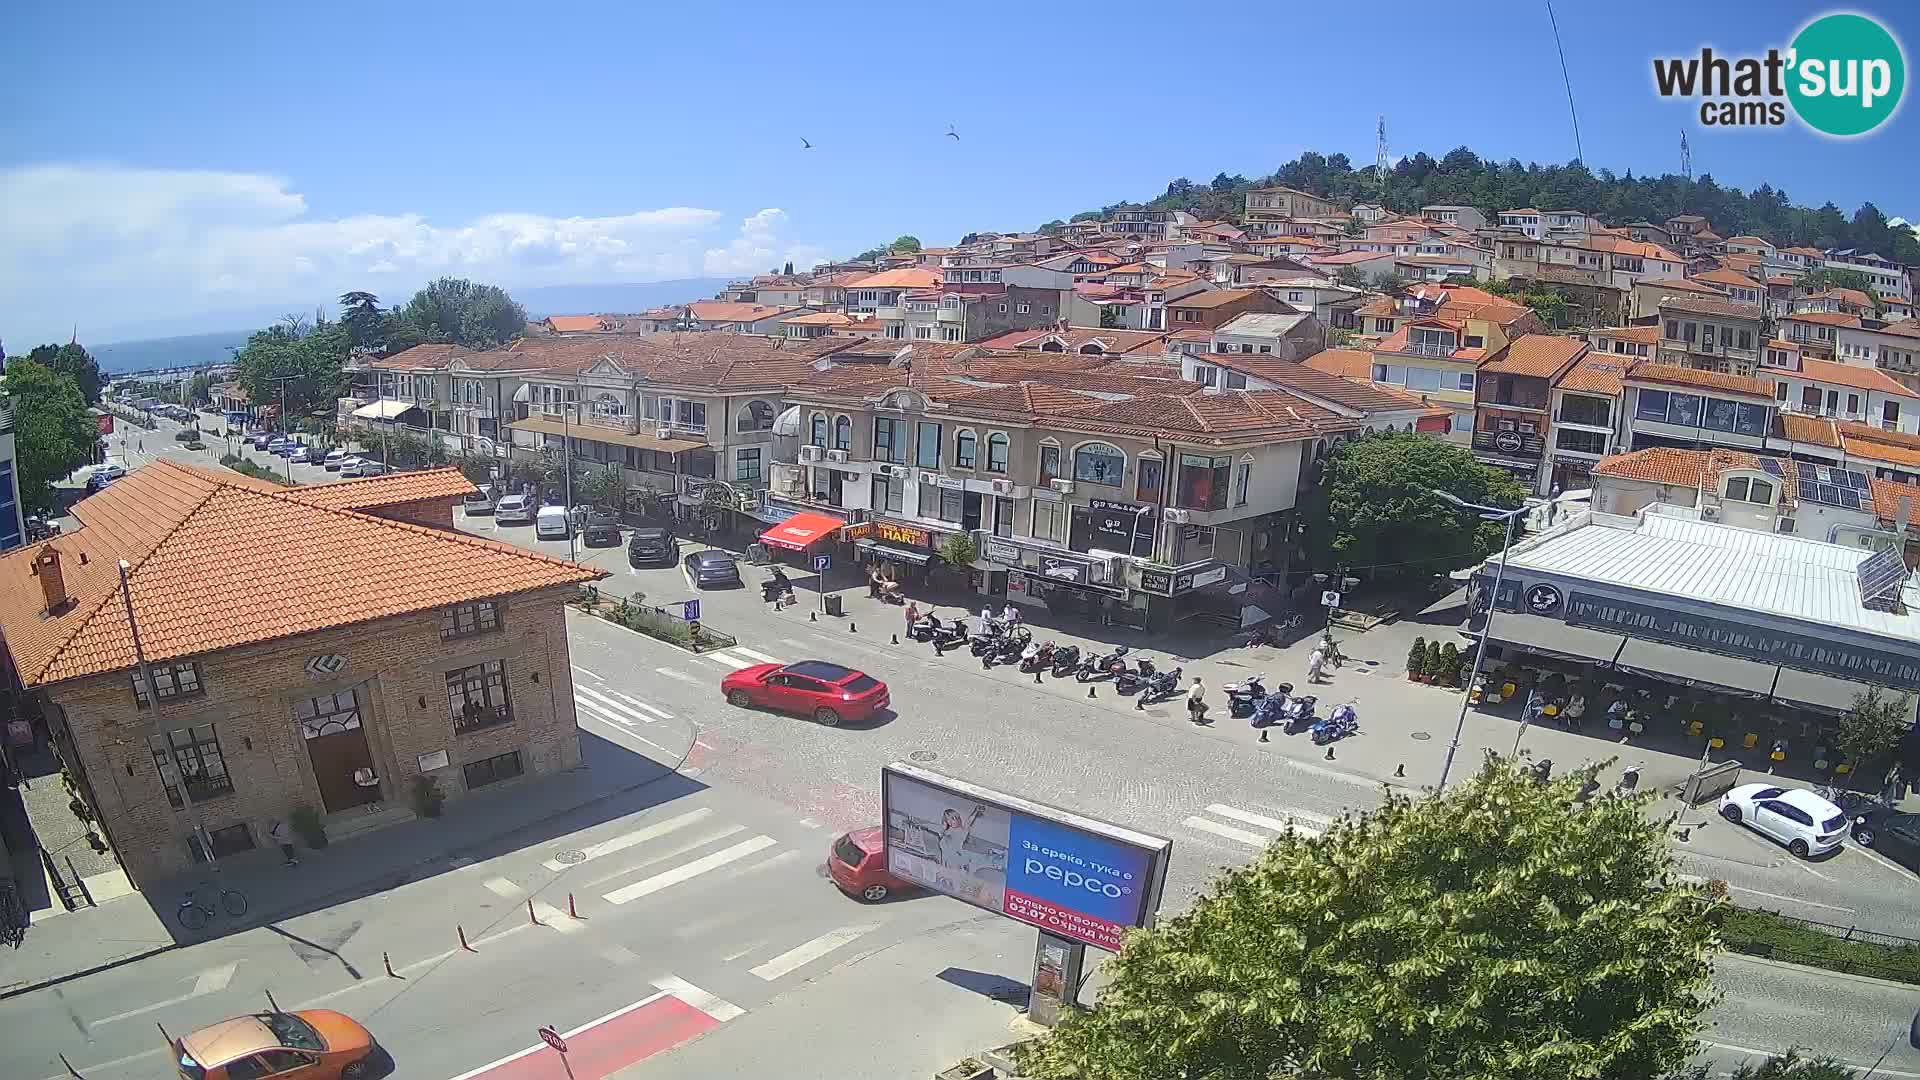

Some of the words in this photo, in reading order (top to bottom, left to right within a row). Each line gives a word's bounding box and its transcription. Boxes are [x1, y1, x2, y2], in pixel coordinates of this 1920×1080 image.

[851, 527, 870, 537] HARI
[883, 529, 915, 545] HARI
[1022, 839, 1039, 852] За
[1089, 862, 1120, 877] тука
[1123, 872, 1133, 880] е
[1009, 902, 1048, 921] 02.07
[542, 1031, 565, 1049] STOP
